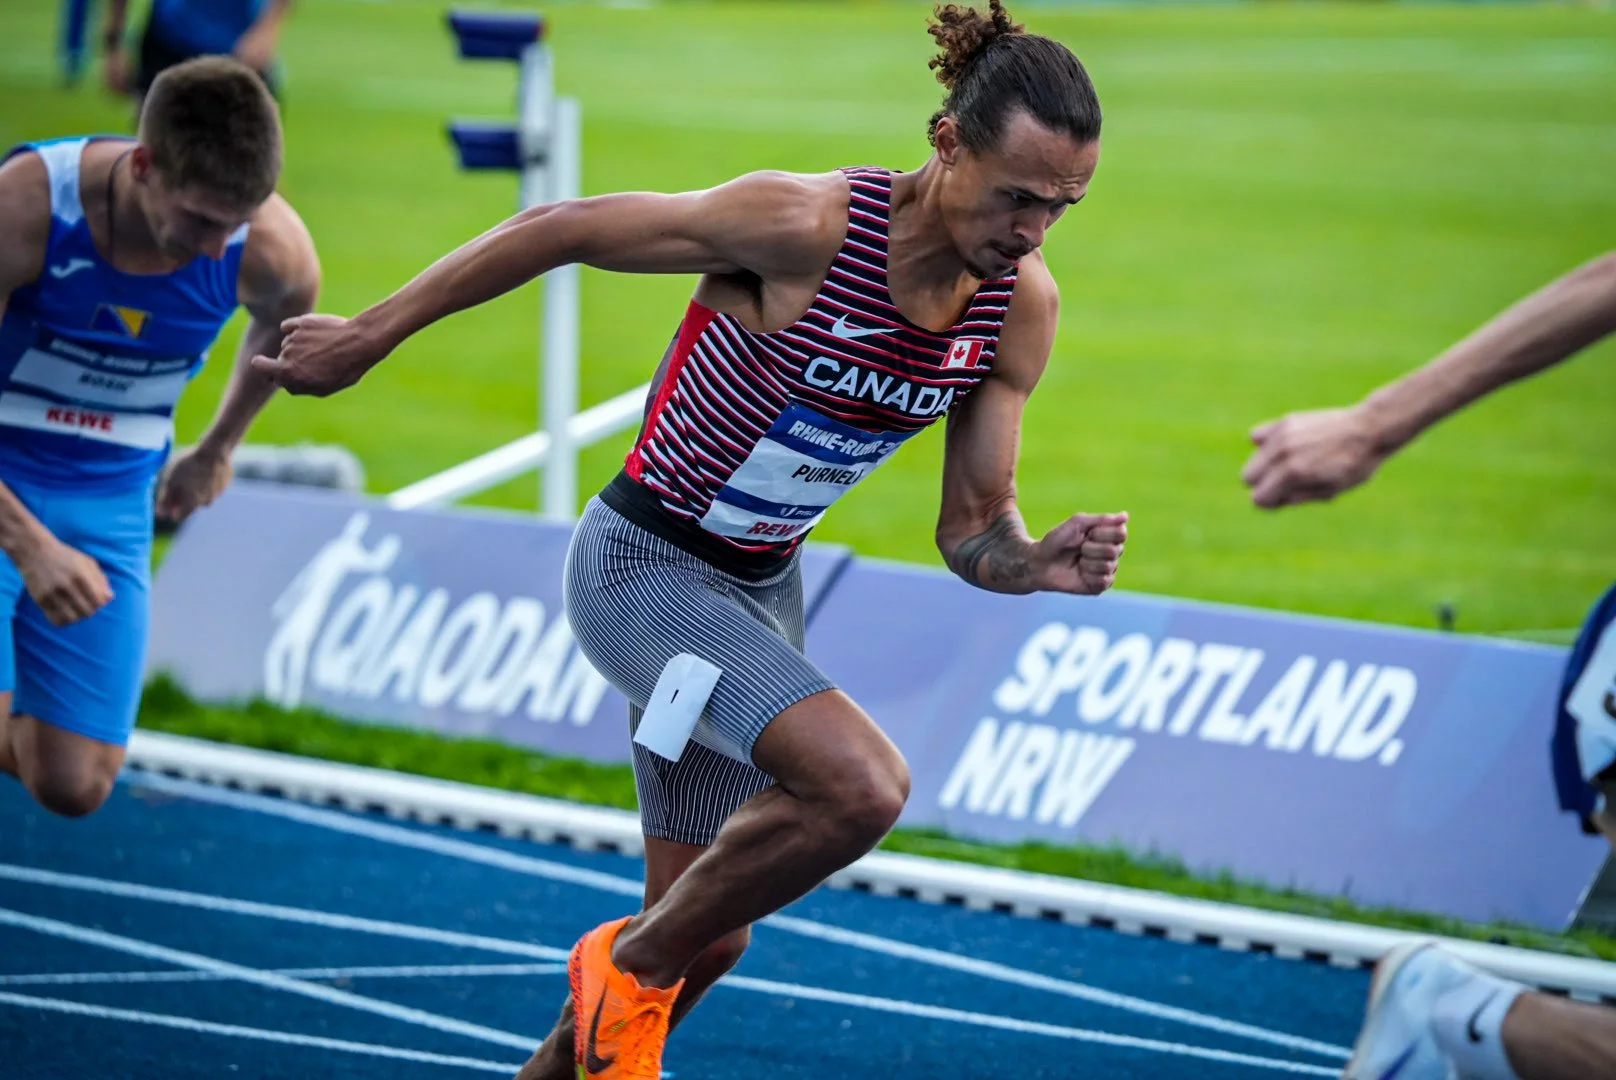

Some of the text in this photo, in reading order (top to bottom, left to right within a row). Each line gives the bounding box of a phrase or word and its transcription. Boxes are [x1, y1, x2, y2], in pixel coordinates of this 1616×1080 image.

[46, 406, 115, 432] REWE
[804, 356, 954, 416] CANADA
[787, 420, 883, 457] RHINE-RUHR
[313, 575, 607, 726] QIAODAN
[993, 621, 1418, 766] SPORTLAND.
[937, 716, 1137, 828] NRW
